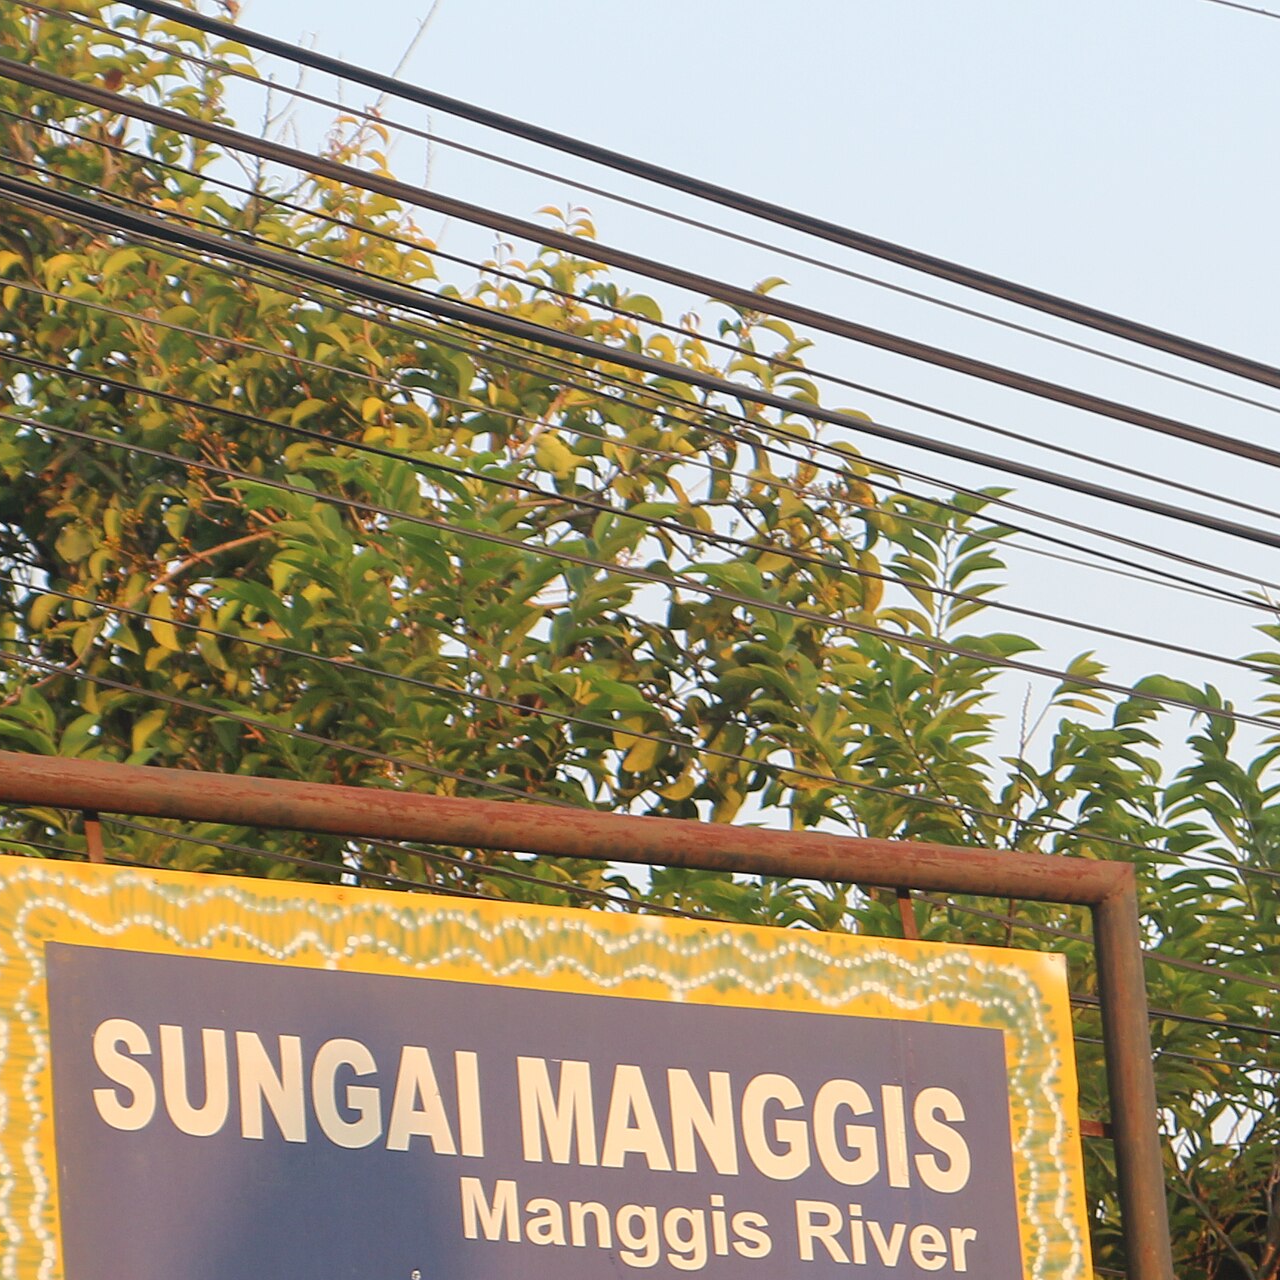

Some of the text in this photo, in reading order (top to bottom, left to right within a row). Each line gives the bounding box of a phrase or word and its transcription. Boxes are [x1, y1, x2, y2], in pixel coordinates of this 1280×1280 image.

[91, 1018, 972, 1194] SUNGAI MANGGIS
[460, 1176, 978, 1272] Manggis River
